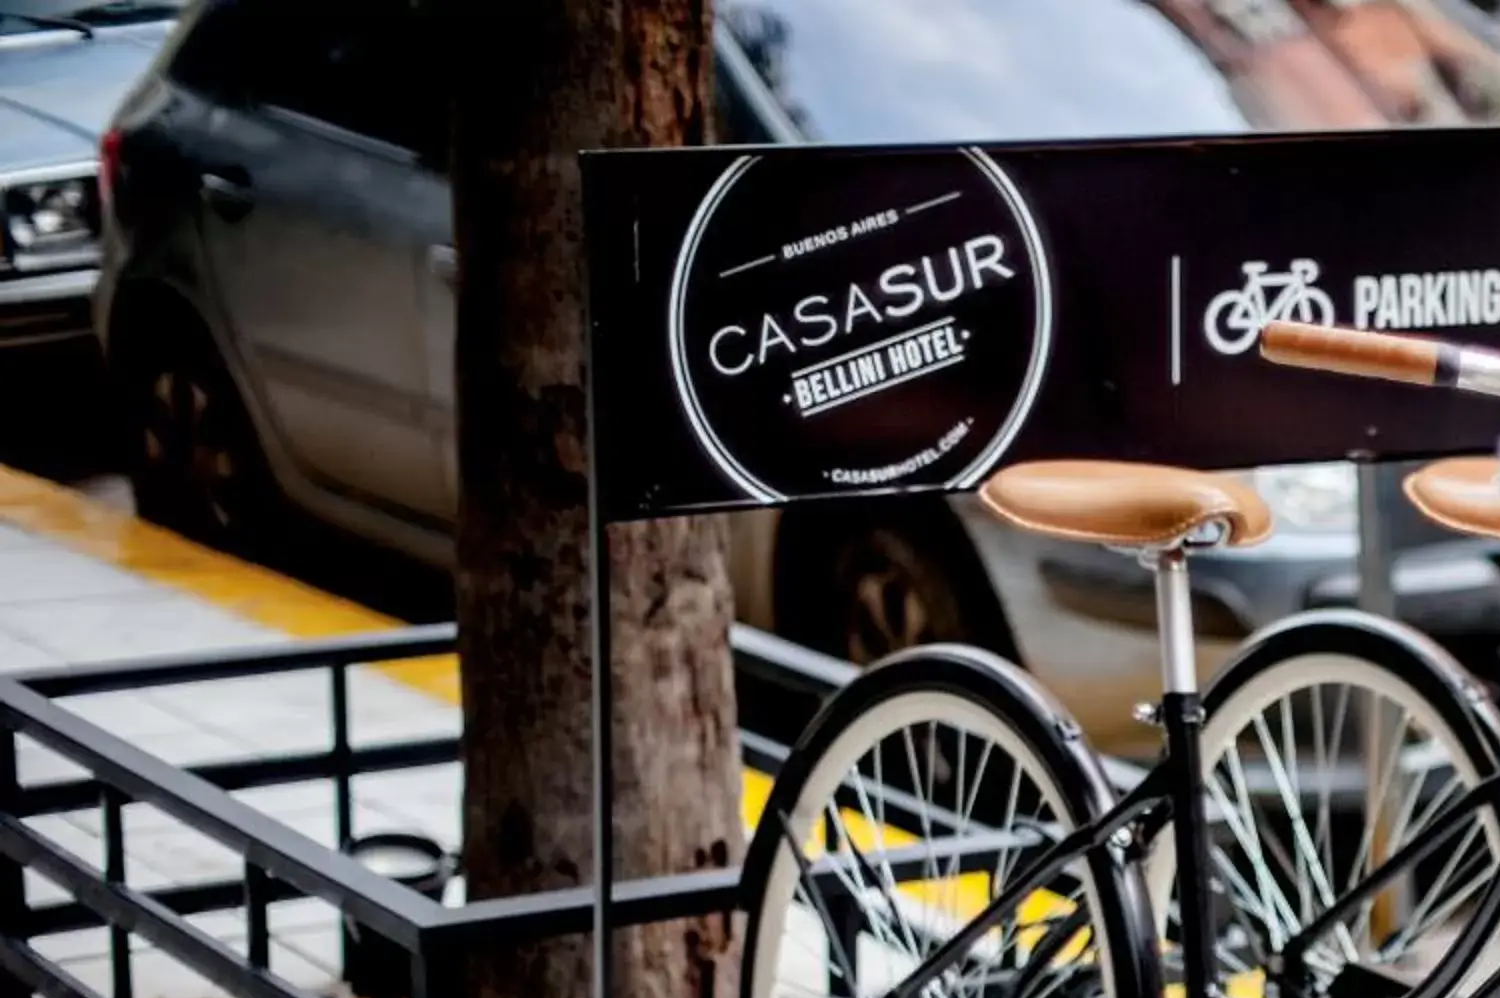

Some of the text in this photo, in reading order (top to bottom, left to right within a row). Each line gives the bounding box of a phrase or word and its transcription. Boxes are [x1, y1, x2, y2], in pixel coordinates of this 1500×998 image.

[781, 209, 899, 260] BUENOS AIRES
[709, 234, 1014, 376] CASASUR
[794, 325, 963, 410] BELLINI HOTEL
[831, 421, 970, 484] CASASURHOTEL.COM
